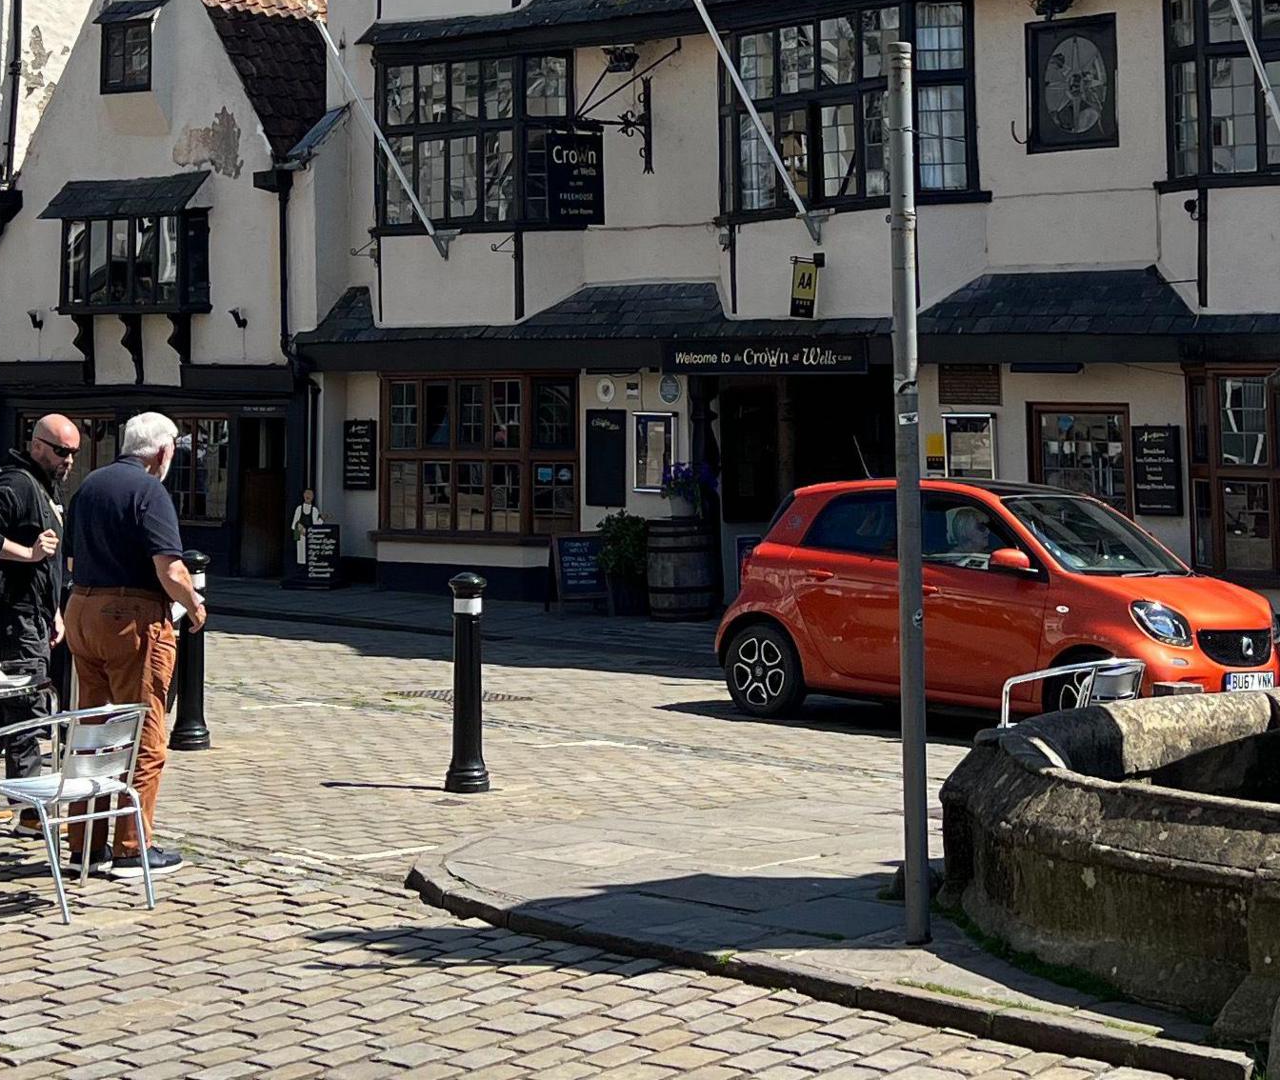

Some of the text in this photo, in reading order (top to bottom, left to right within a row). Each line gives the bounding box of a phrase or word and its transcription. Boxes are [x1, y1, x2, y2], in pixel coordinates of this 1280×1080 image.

[552, 145, 597, 164] Crown
[797, 272, 813, 290] AA
[675, 351, 718, 364] Welcome
[721, 352, 731, 364] to
[743, 347, 789, 368] Crown
[802, 347, 837, 365] Wells
[1232, 674, 1254, 690] BU67
